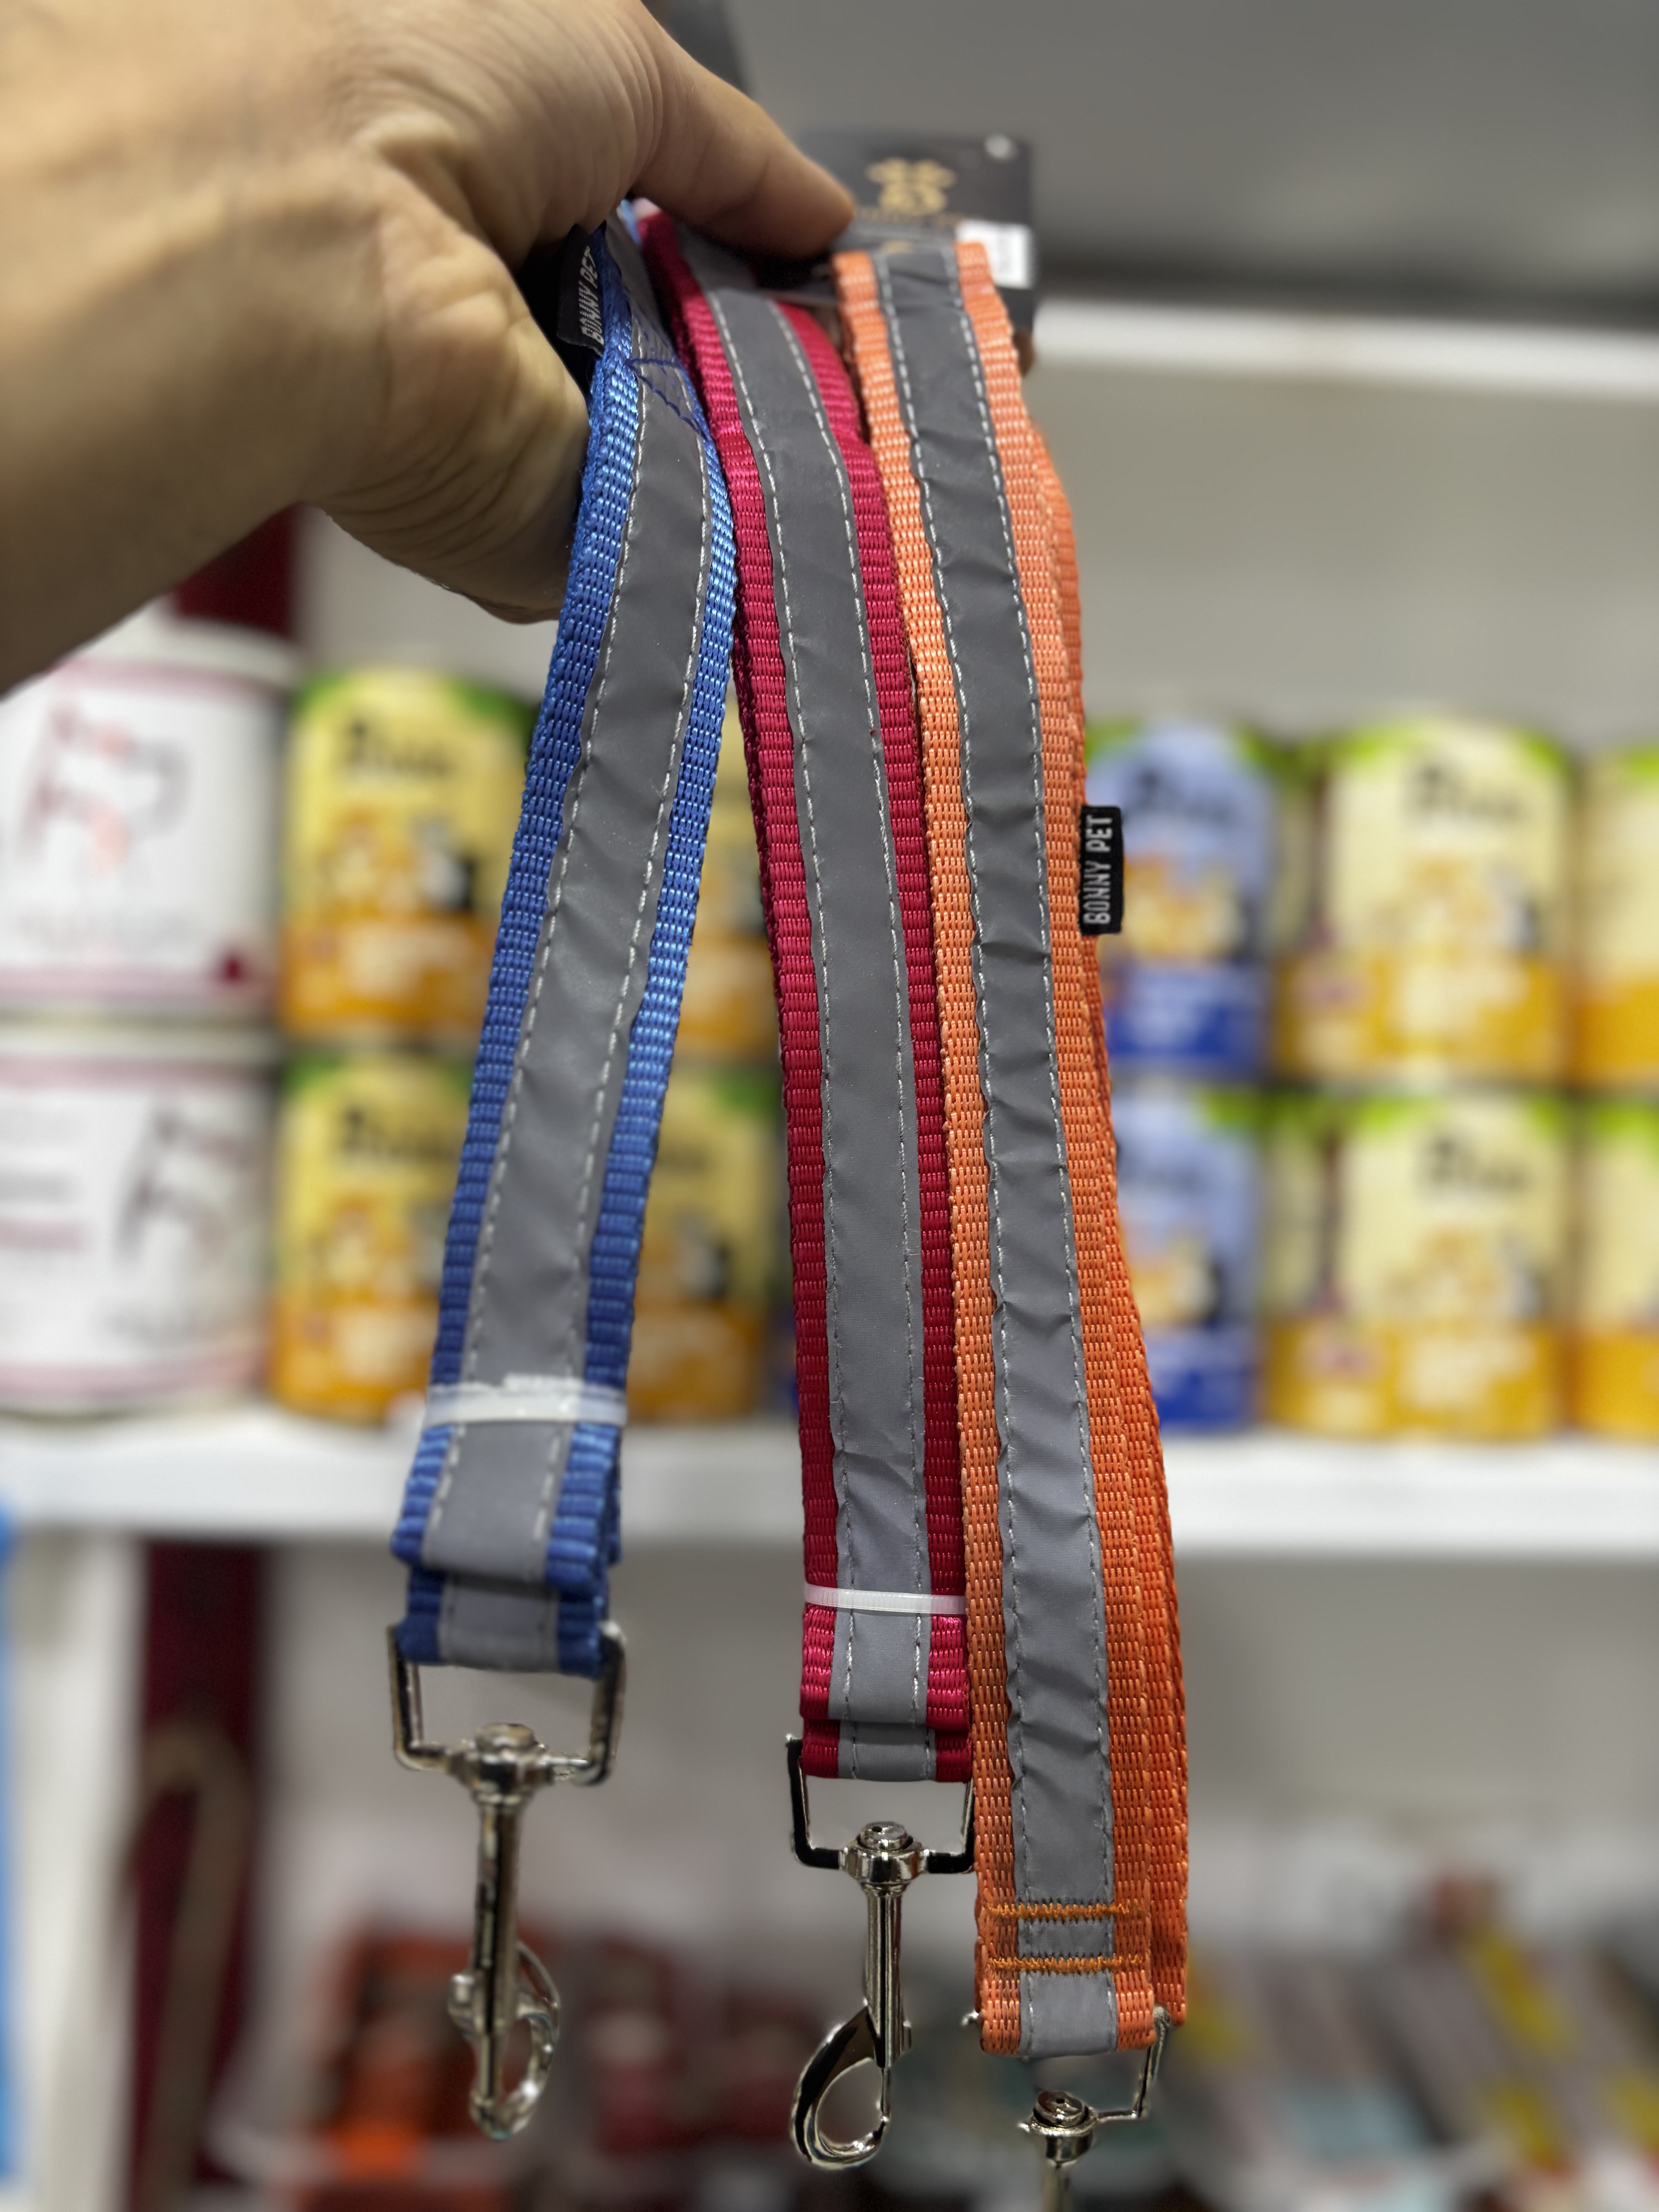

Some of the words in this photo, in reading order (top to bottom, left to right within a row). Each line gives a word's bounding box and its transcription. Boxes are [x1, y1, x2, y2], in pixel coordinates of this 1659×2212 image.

[579, 280, 605, 346] BONNY
[1085, 814, 1113, 852] PET
[1083, 860, 1111, 924] BONNY
